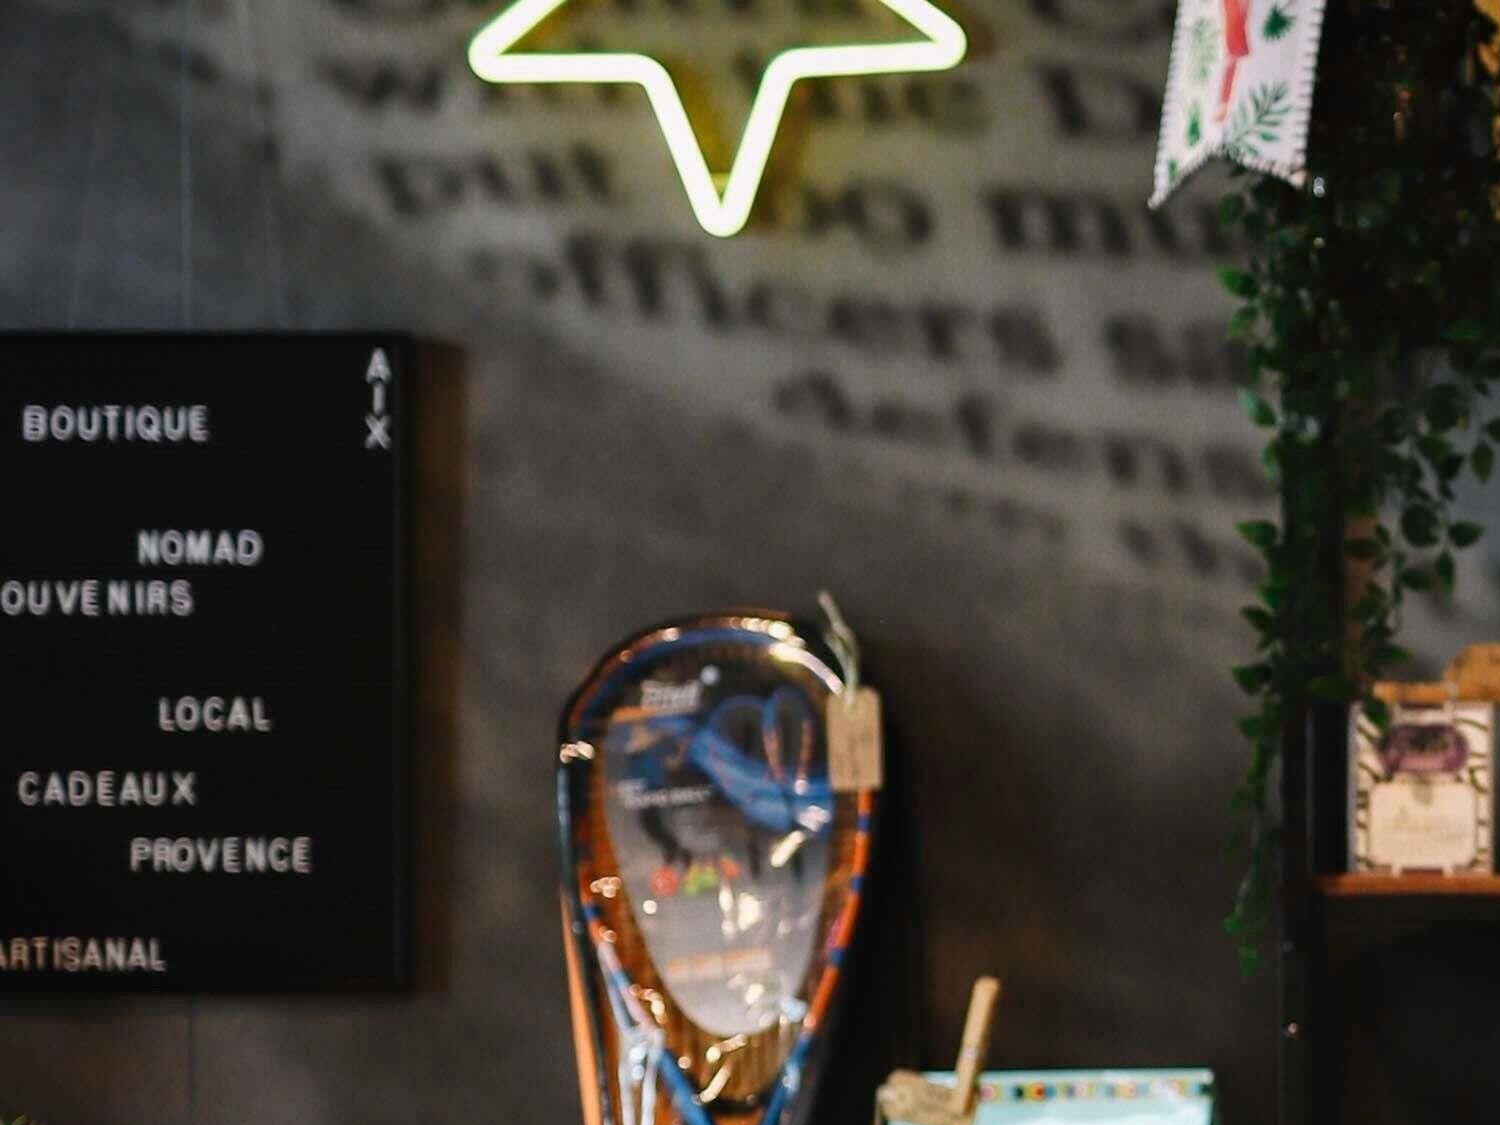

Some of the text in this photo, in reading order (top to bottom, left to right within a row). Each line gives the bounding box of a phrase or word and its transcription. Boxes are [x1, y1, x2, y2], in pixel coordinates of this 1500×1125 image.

[365, 348, 392, 449] AIX
[22, 405, 209, 442] BOUTIQUE
[137, 530, 263, 566] NOMAD
[158, 697, 273, 732] LOCAL
[18, 771, 198, 806] CADEAUX
[130, 836, 312, 873] PROVENCE
